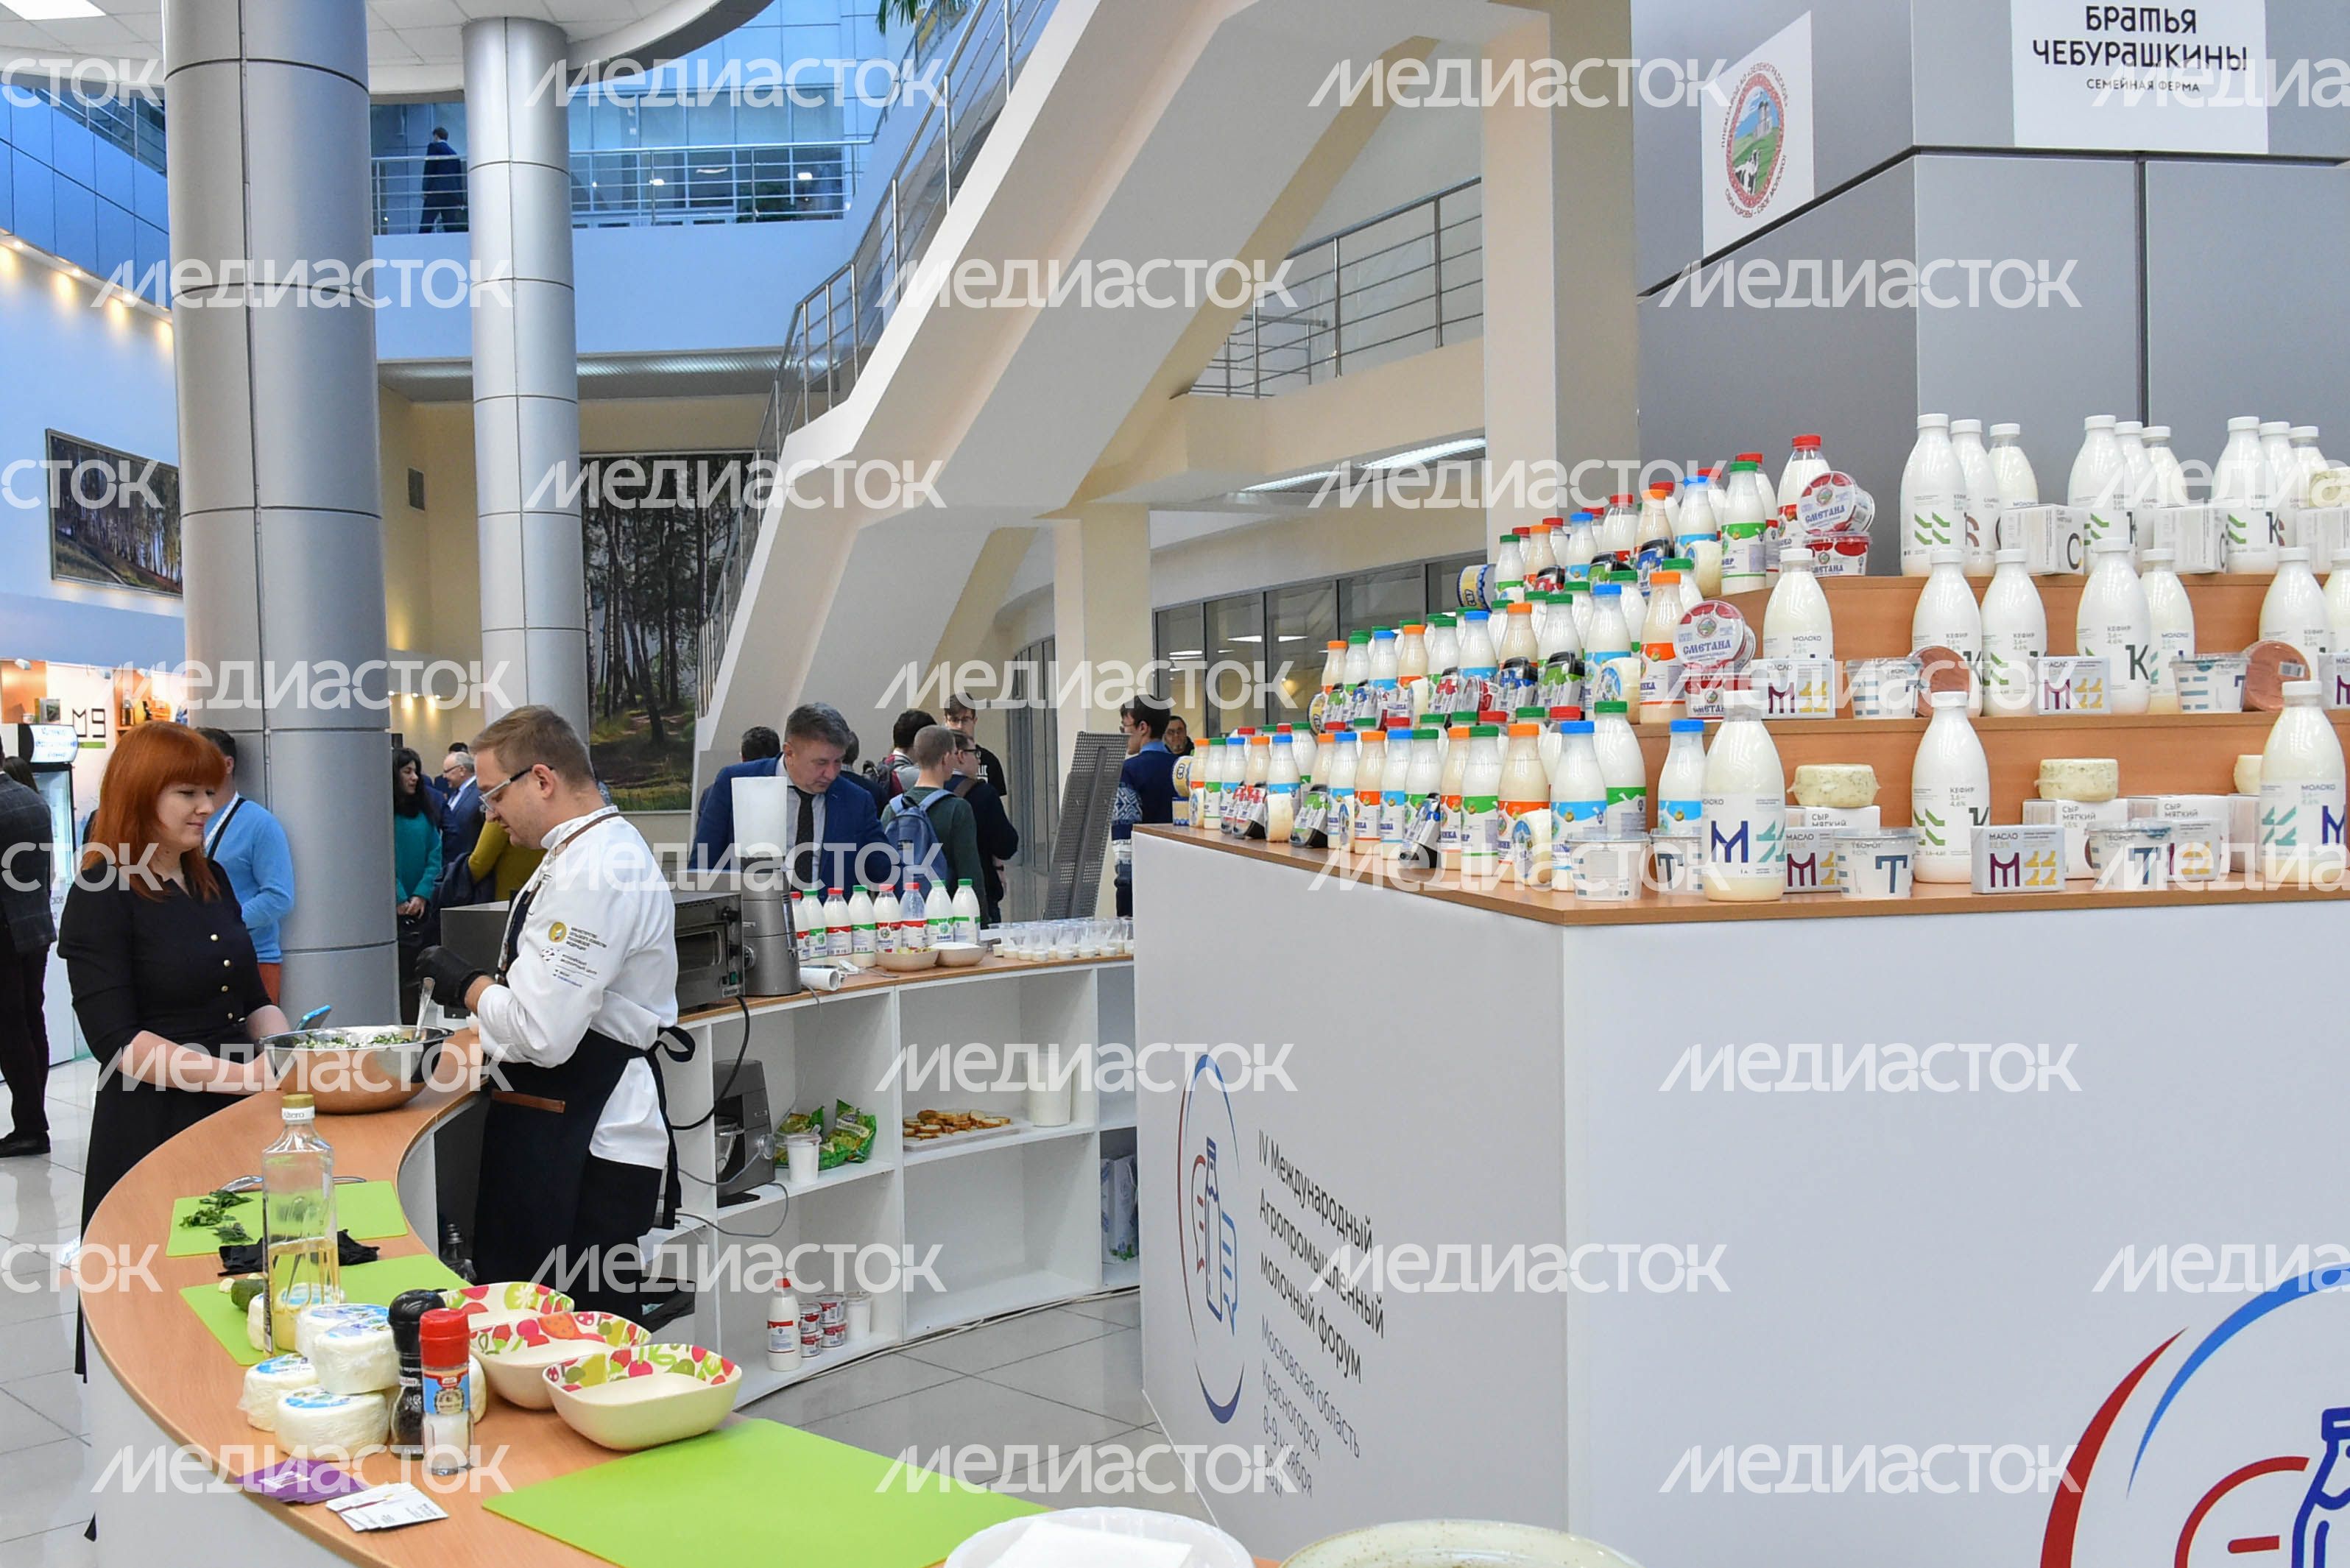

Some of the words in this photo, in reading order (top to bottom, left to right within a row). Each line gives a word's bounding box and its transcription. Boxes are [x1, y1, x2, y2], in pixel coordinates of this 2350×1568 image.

[2086, 77, 2154, 91] СЕМЕЙНАЯ
[2158, 80, 2200, 92] ФЕРМА
[1259, 1129, 1268, 1167] IV
[1271, 1140, 1372, 1258] Международный
[1260, 1187, 1384, 1339] Агропромышленный
[1261, 1251, 1315, 1332] молочный
[1318, 1306, 1361, 1384] форум
[1262, 1313, 1315, 1403] Московская
[1317, 1390, 1360, 1459] область
[1263, 1359, 1320, 1461] Красногорск
